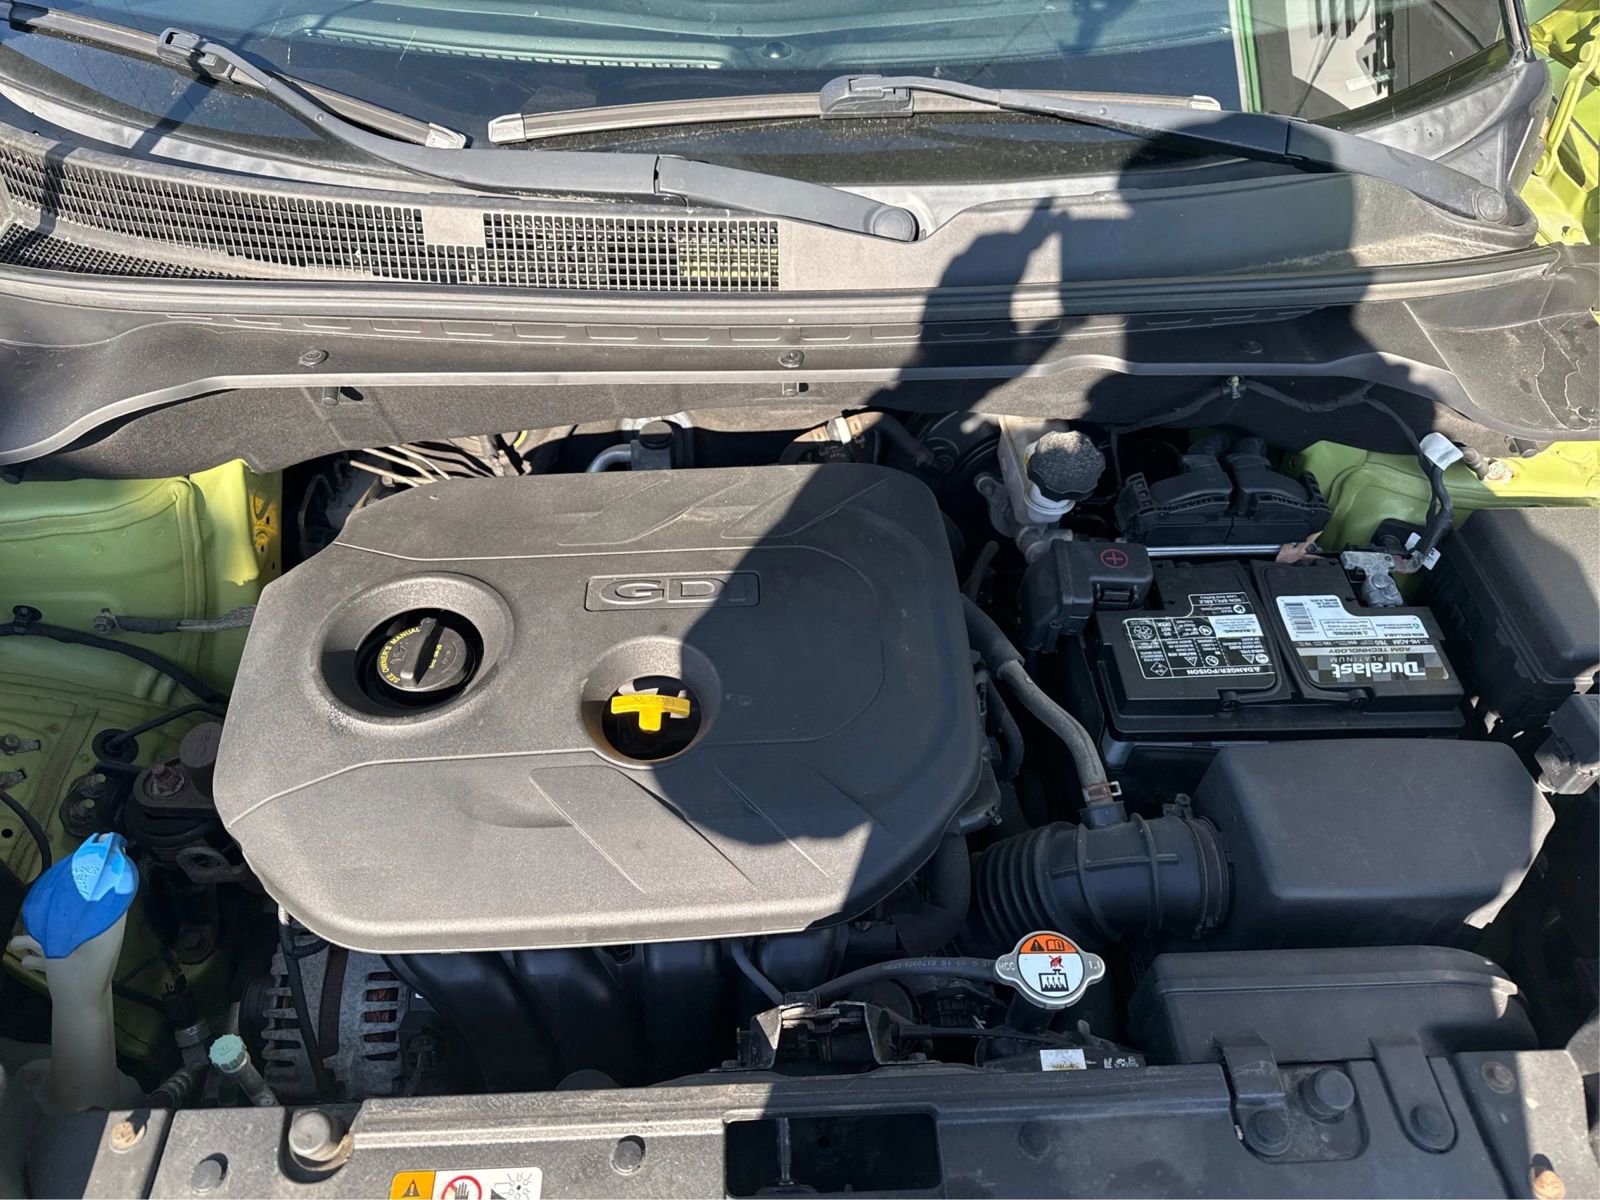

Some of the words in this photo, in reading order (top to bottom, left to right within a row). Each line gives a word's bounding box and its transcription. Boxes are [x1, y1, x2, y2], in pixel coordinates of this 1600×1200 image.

[599, 577, 746, 605] GDI
[1329, 655, 1384, 663] PLATINUM
[1187, 666, 1253, 676] DANGER/POISON
[1331, 661, 1426, 679] Duralast
[998, 962, 1016, 972] HCC
